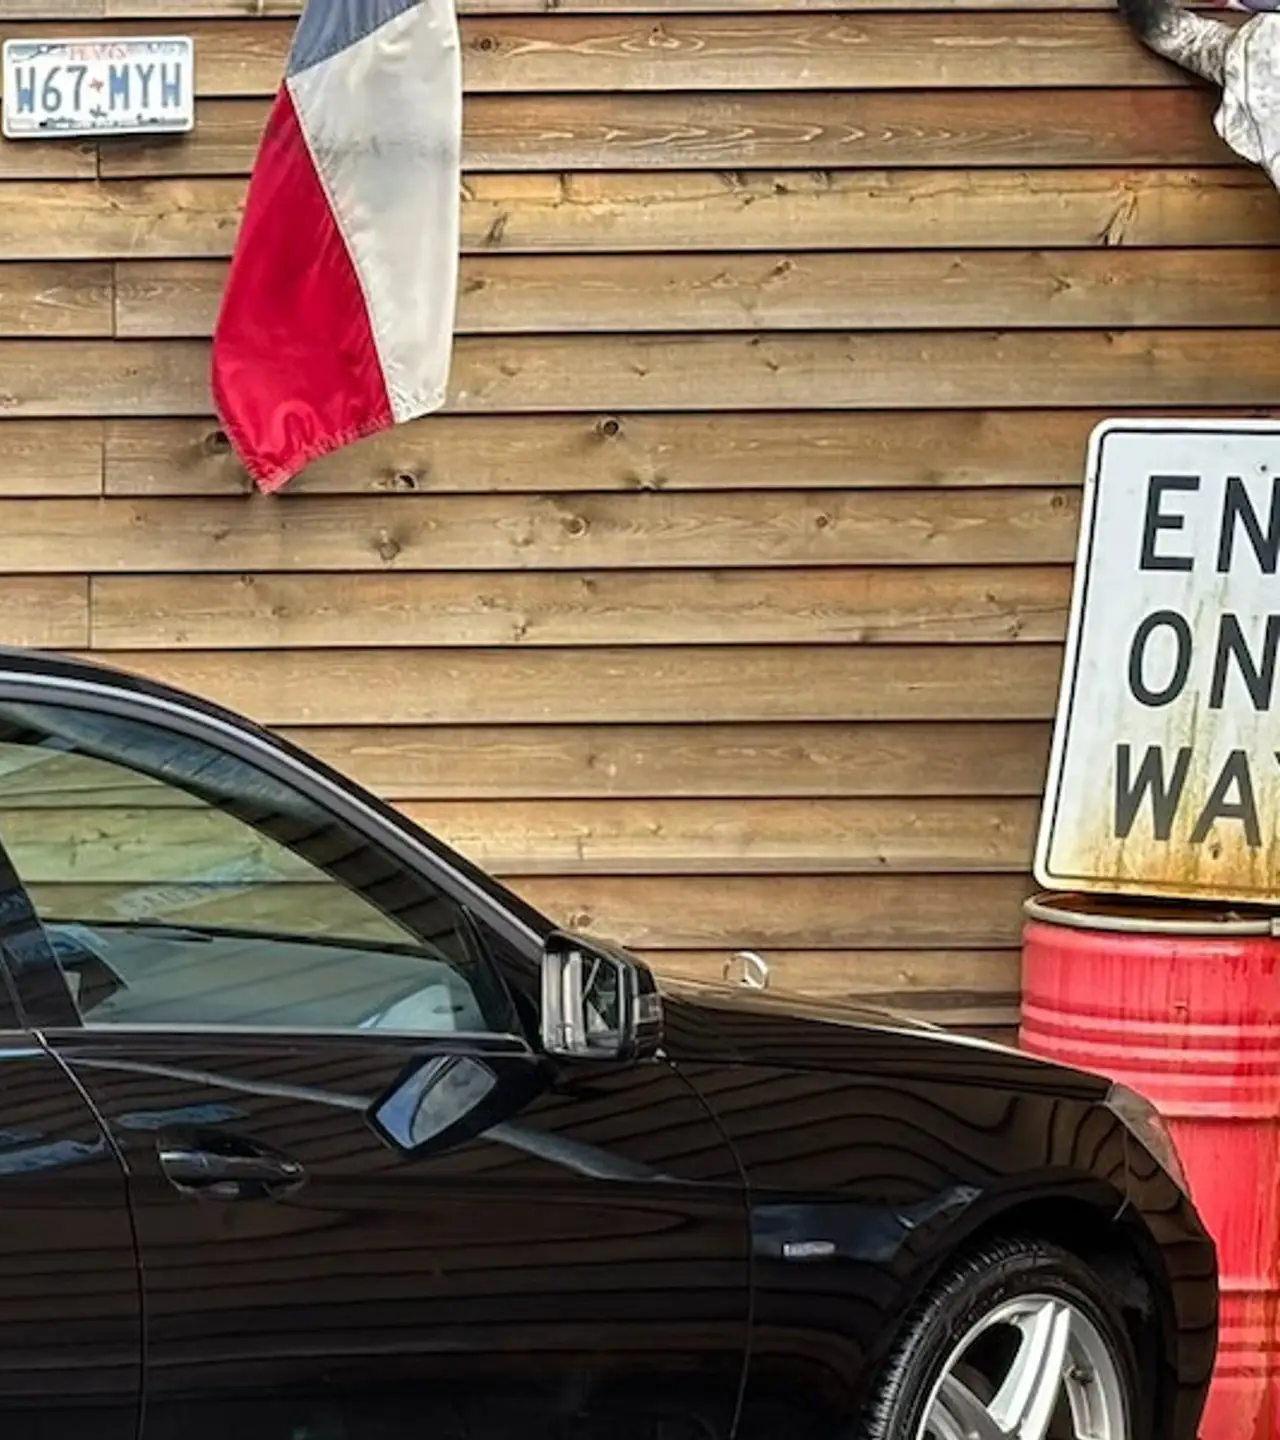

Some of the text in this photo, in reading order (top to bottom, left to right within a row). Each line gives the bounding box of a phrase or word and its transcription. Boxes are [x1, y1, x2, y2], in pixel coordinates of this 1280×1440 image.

[1139, 475, 1280, 574] EN
[1129, 610, 1280, 713] ON
[1115, 744, 1280, 847] WA
